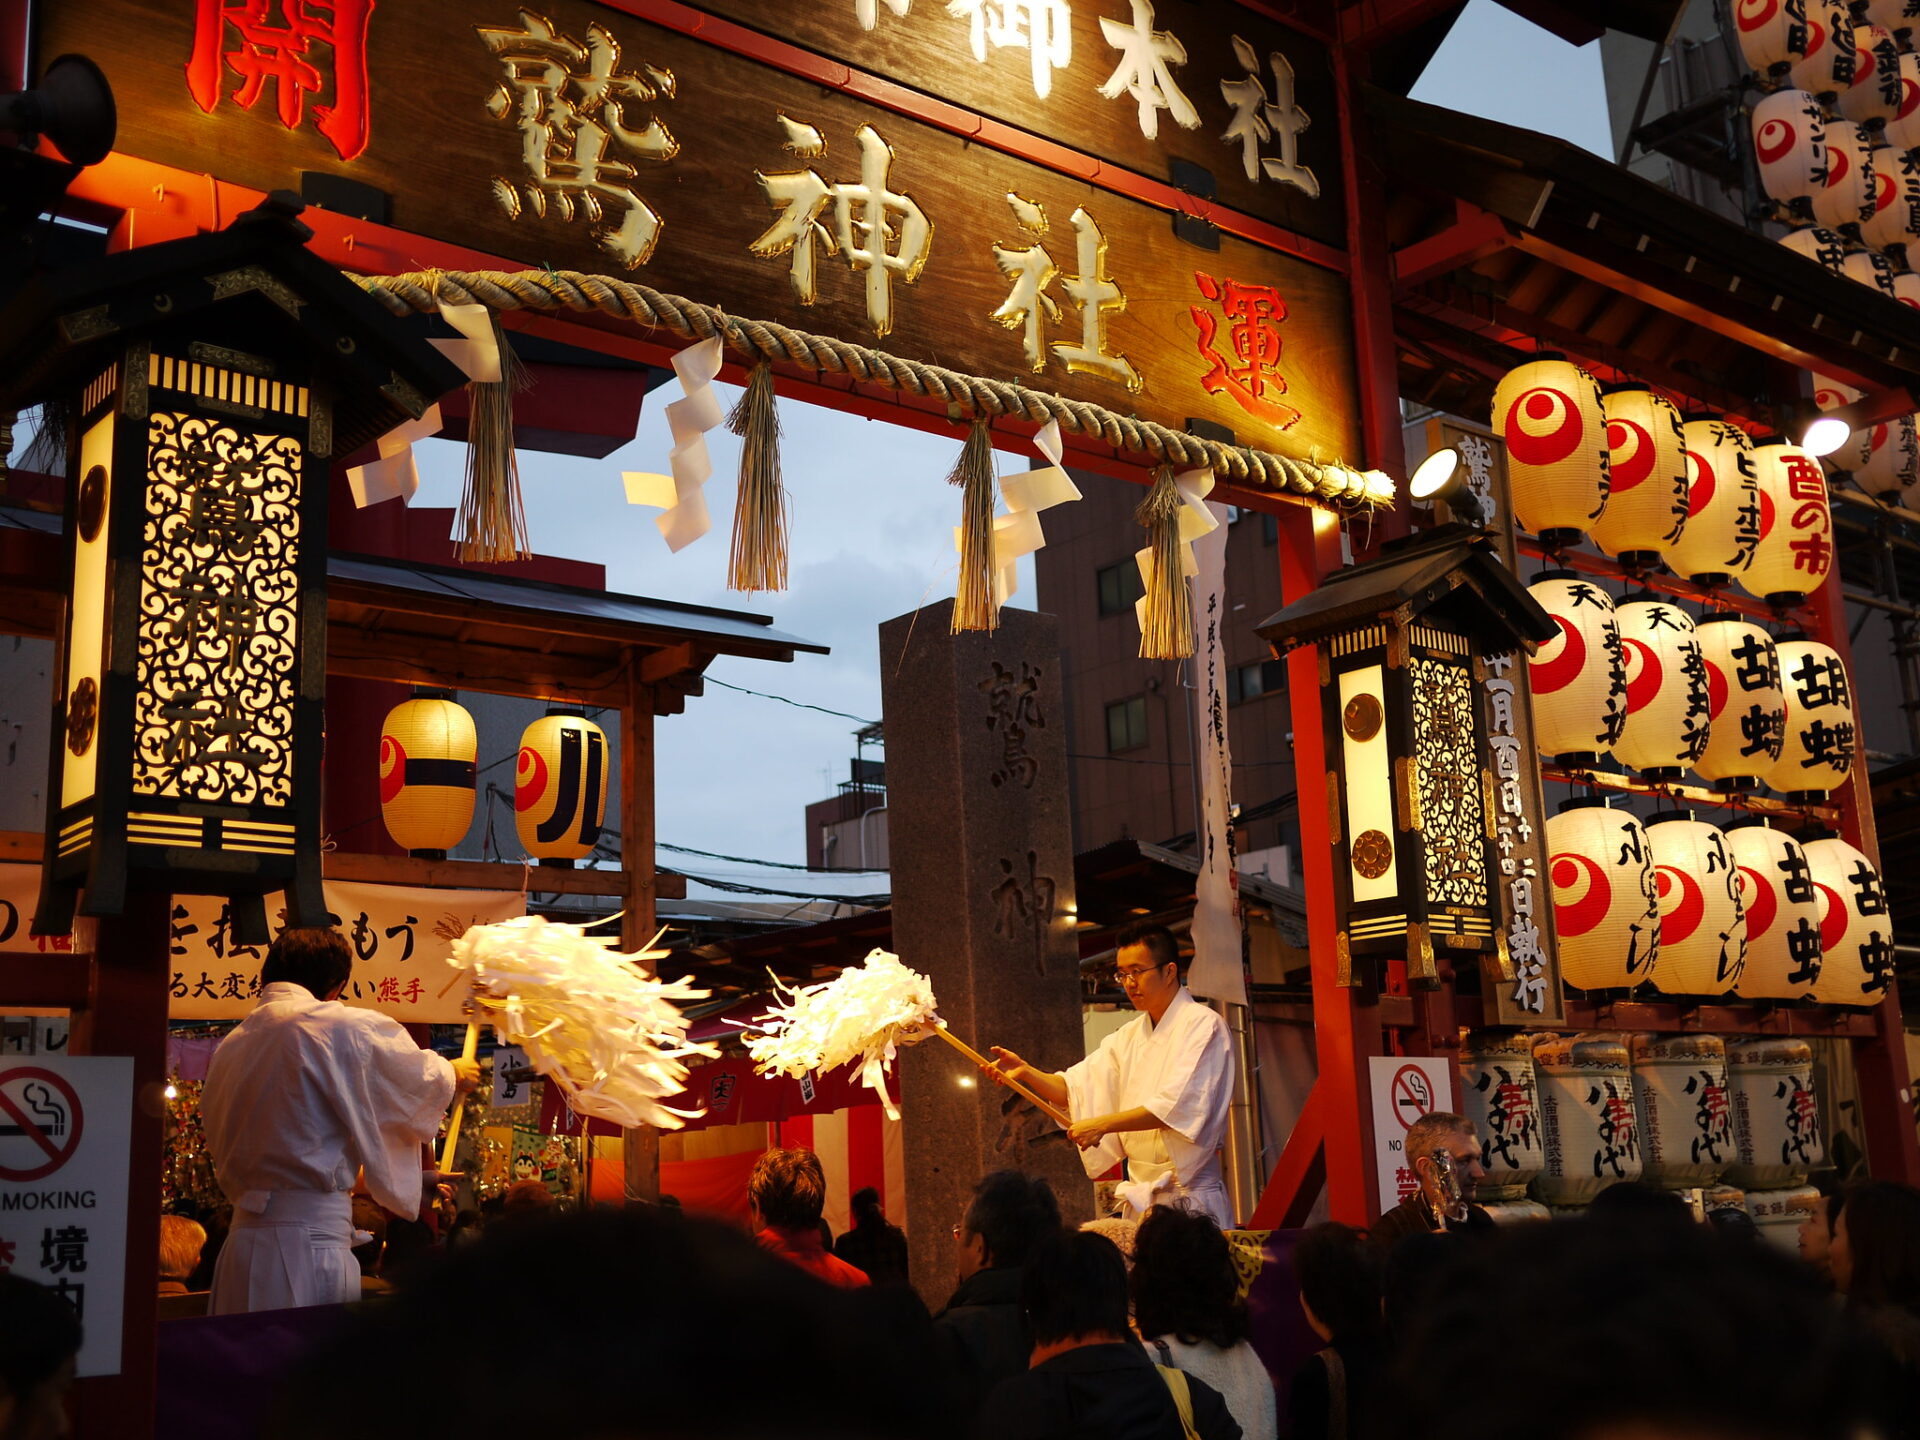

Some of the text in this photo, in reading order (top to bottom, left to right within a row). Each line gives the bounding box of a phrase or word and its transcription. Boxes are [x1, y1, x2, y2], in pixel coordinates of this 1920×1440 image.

[472, 6, 1144, 394] 鷲神社
[1189, 270, 1302, 430] 運
[1731, 634, 1785, 762] 胡蝶
[1791, 653, 1856, 773] 胡蝶
[1388, 1140, 1402, 1151] NO
